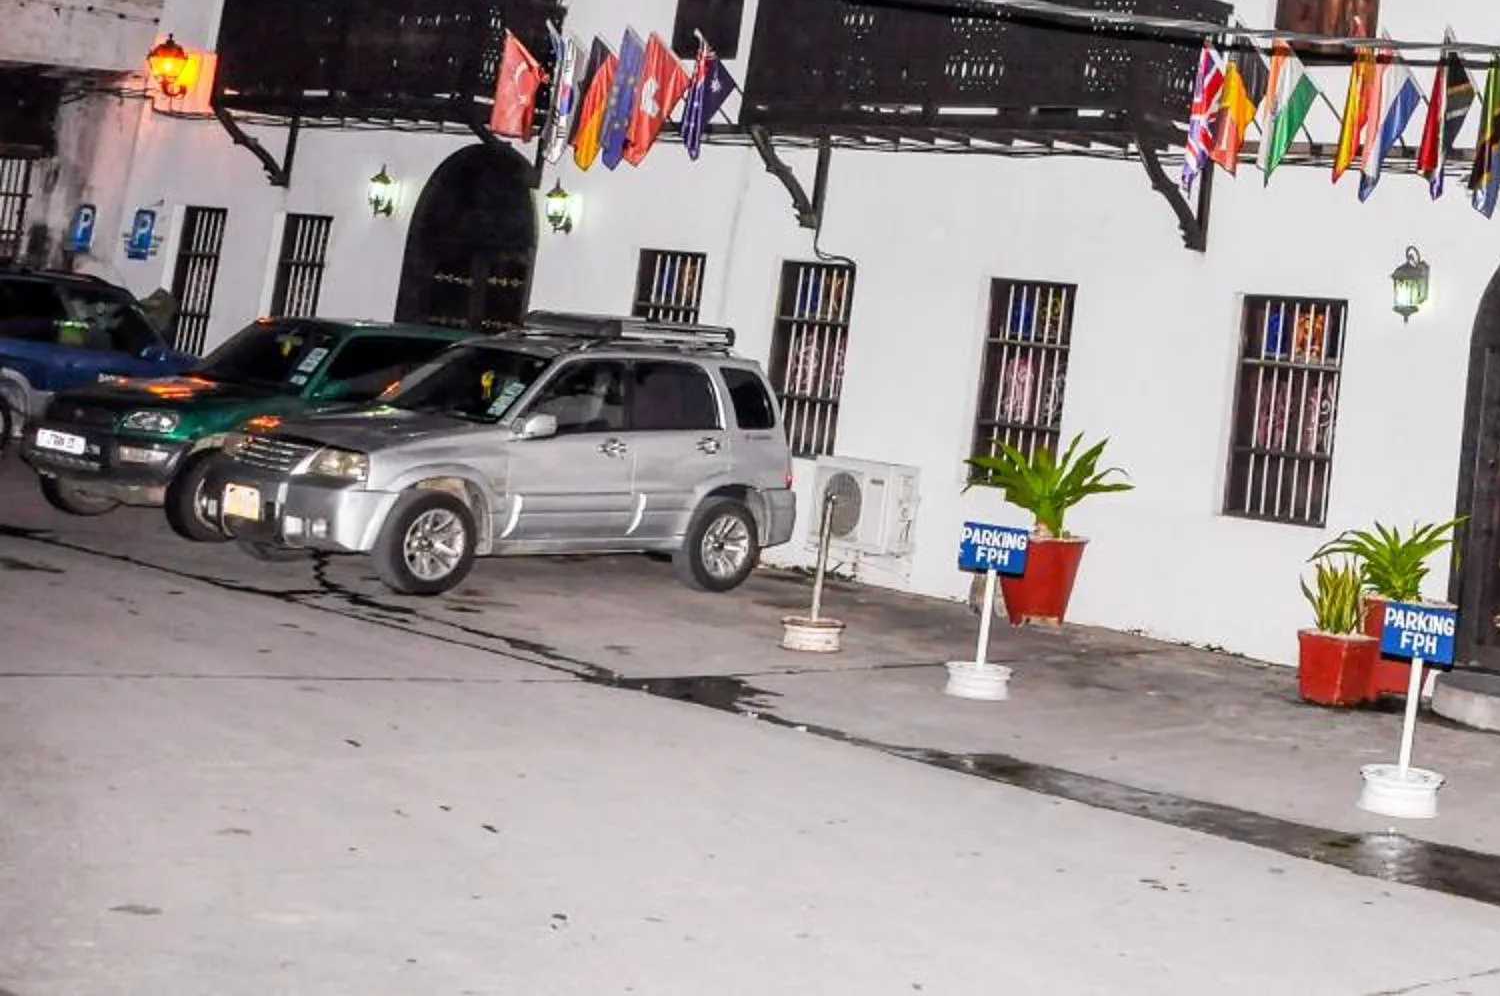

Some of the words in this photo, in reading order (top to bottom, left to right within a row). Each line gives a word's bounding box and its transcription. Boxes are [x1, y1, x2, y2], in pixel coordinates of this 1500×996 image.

[961, 527, 1026, 551] PARKING
[976, 545, 1010, 566] FPH
[1384, 607, 1455, 637] PARKING
[1400, 630, 1437, 655] FPH
